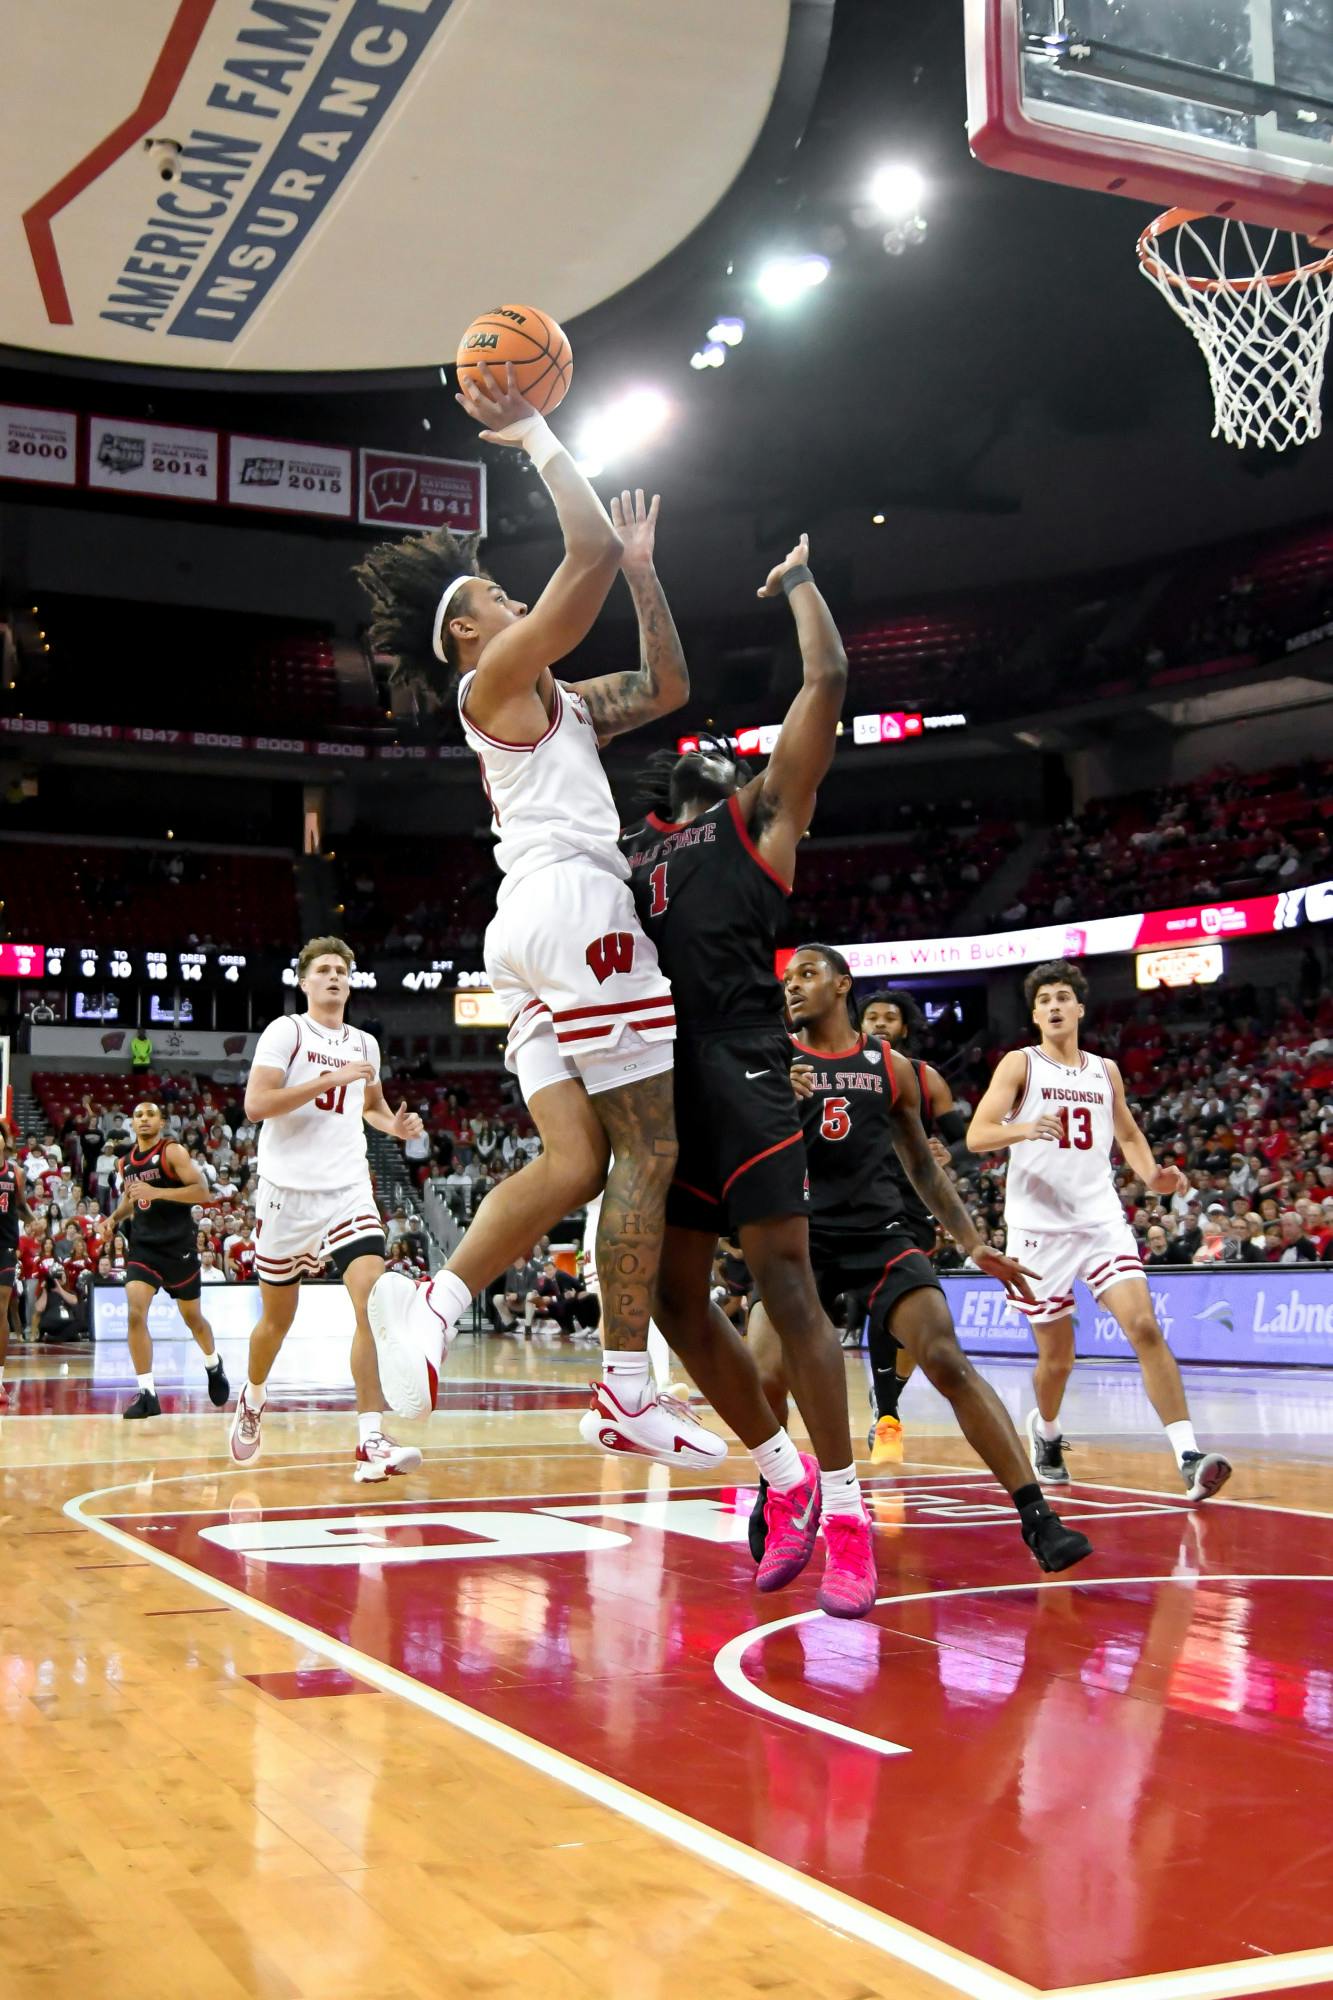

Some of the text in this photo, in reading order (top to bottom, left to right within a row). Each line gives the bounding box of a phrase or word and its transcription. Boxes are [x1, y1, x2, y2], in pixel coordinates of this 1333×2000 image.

[99, 129, 262, 333] AMERICAN
[8, 439, 67, 460] 2000
[152, 457, 208, 477] 2014
[288, 474, 342, 494] 2015
[420, 497, 471, 516] 1941
[1, 717, 49, 733] 1935
[68, 722, 114, 738] 1941
[133, 727, 180, 743] 1947
[194, 733, 243, 748] 2002
[256, 737, 305, 753] 2003
[381, 746, 426, 759] 2015
[661, 822, 717, 856] STATE
[649, 861, 669, 918] 1
[46, 948, 65, 958] AST
[81, 949, 98, 960] STL
[113, 950, 128, 961] TO
[146, 952, 167, 963] REB
[180, 953, 207, 965] DREB
[219, 955, 246, 967] OREB
[432, 961, 453, 970] 3-PT
[585, 931, 635, 986] W
[848, 942, 1028, 969] Bank With Bucky
[110, 961, 132, 978] 10
[181, 963, 202, 981] 14
[224, 965, 239, 982] 4
[402, 971, 443, 991] 4/17
[835, 1071, 883, 1094] STATE
[1041, 1087, 1104, 1105] WISCONSIN
[819, 1096, 851, 1142] 5
[1055, 1106, 1093, 1151] 13
